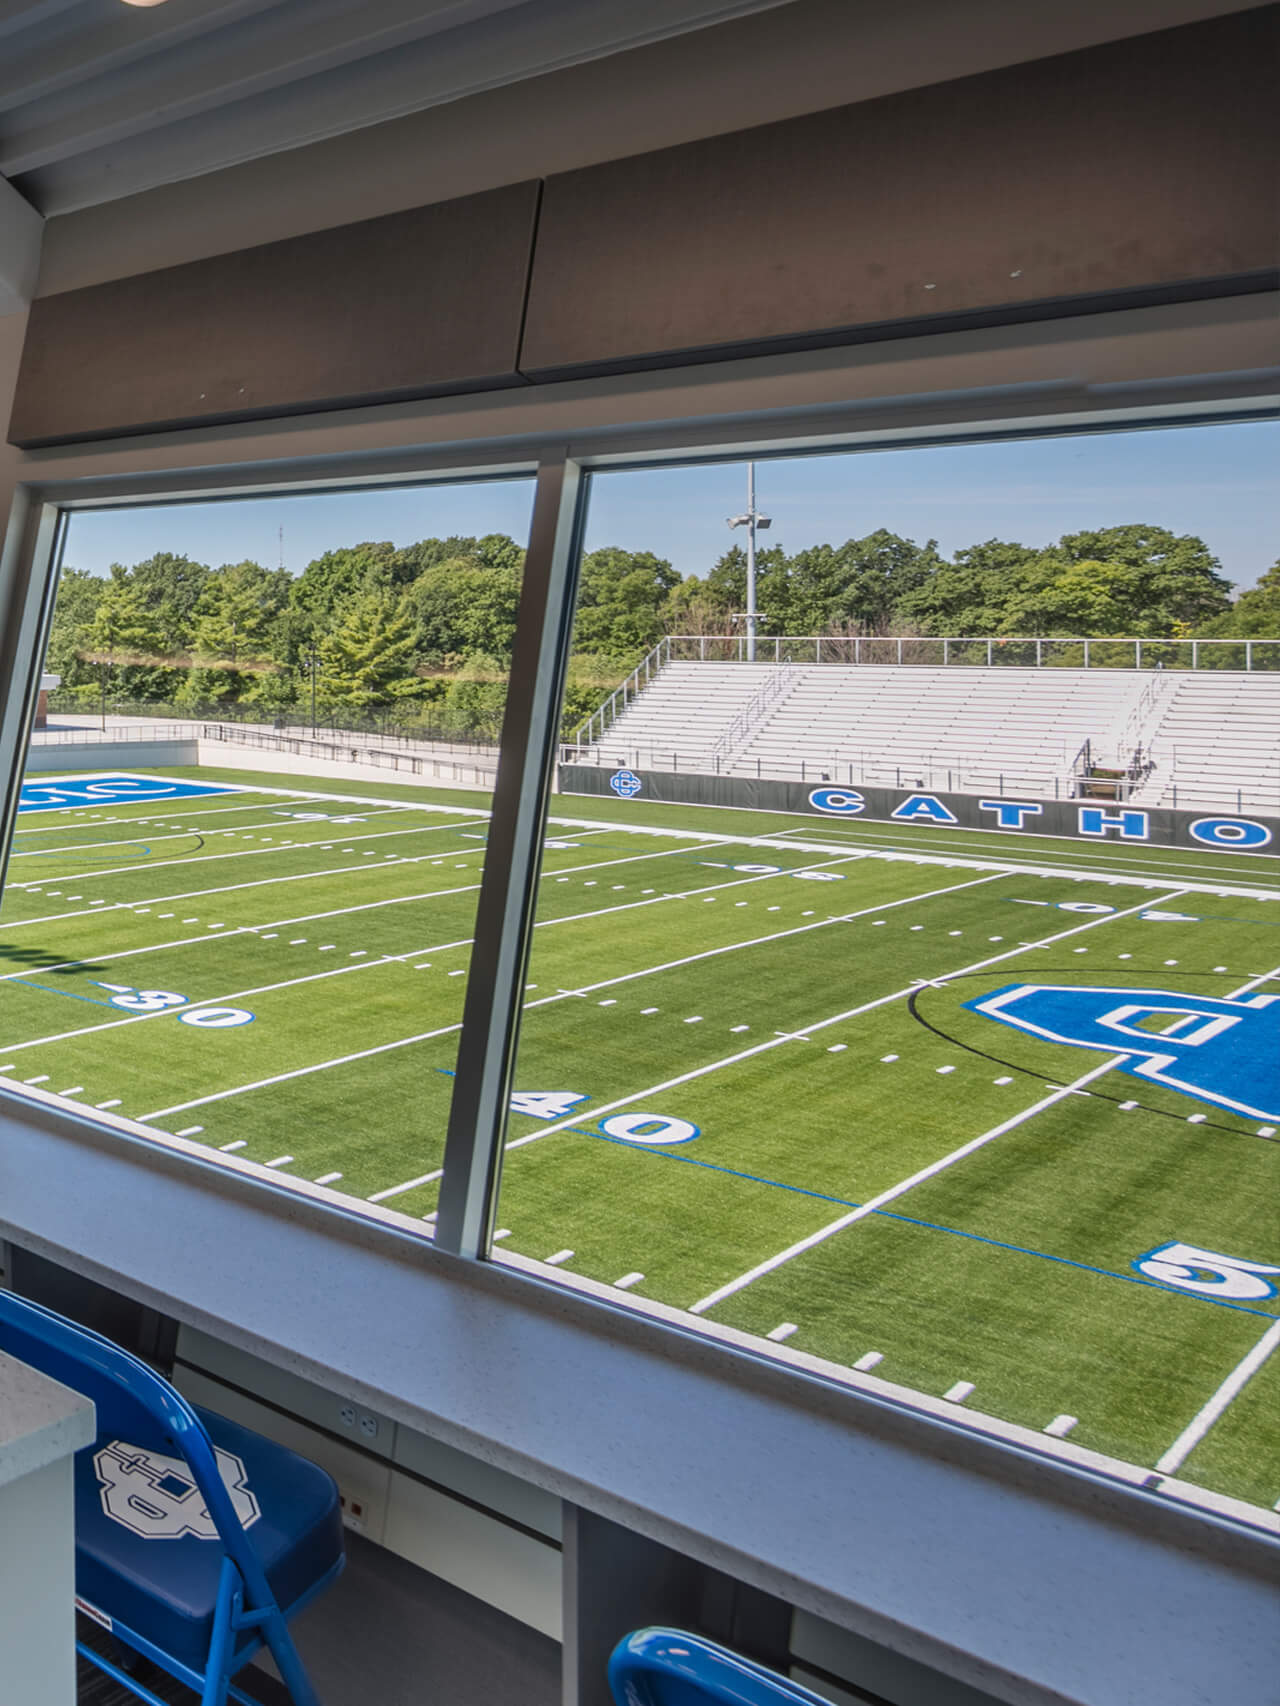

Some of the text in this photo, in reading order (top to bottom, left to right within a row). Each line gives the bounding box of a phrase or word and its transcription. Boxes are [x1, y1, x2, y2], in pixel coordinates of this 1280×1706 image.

[810, 787, 1273, 849] CATHO
[108, 989, 257, 1029] 30
[510, 1090, 701, 1146] 40
